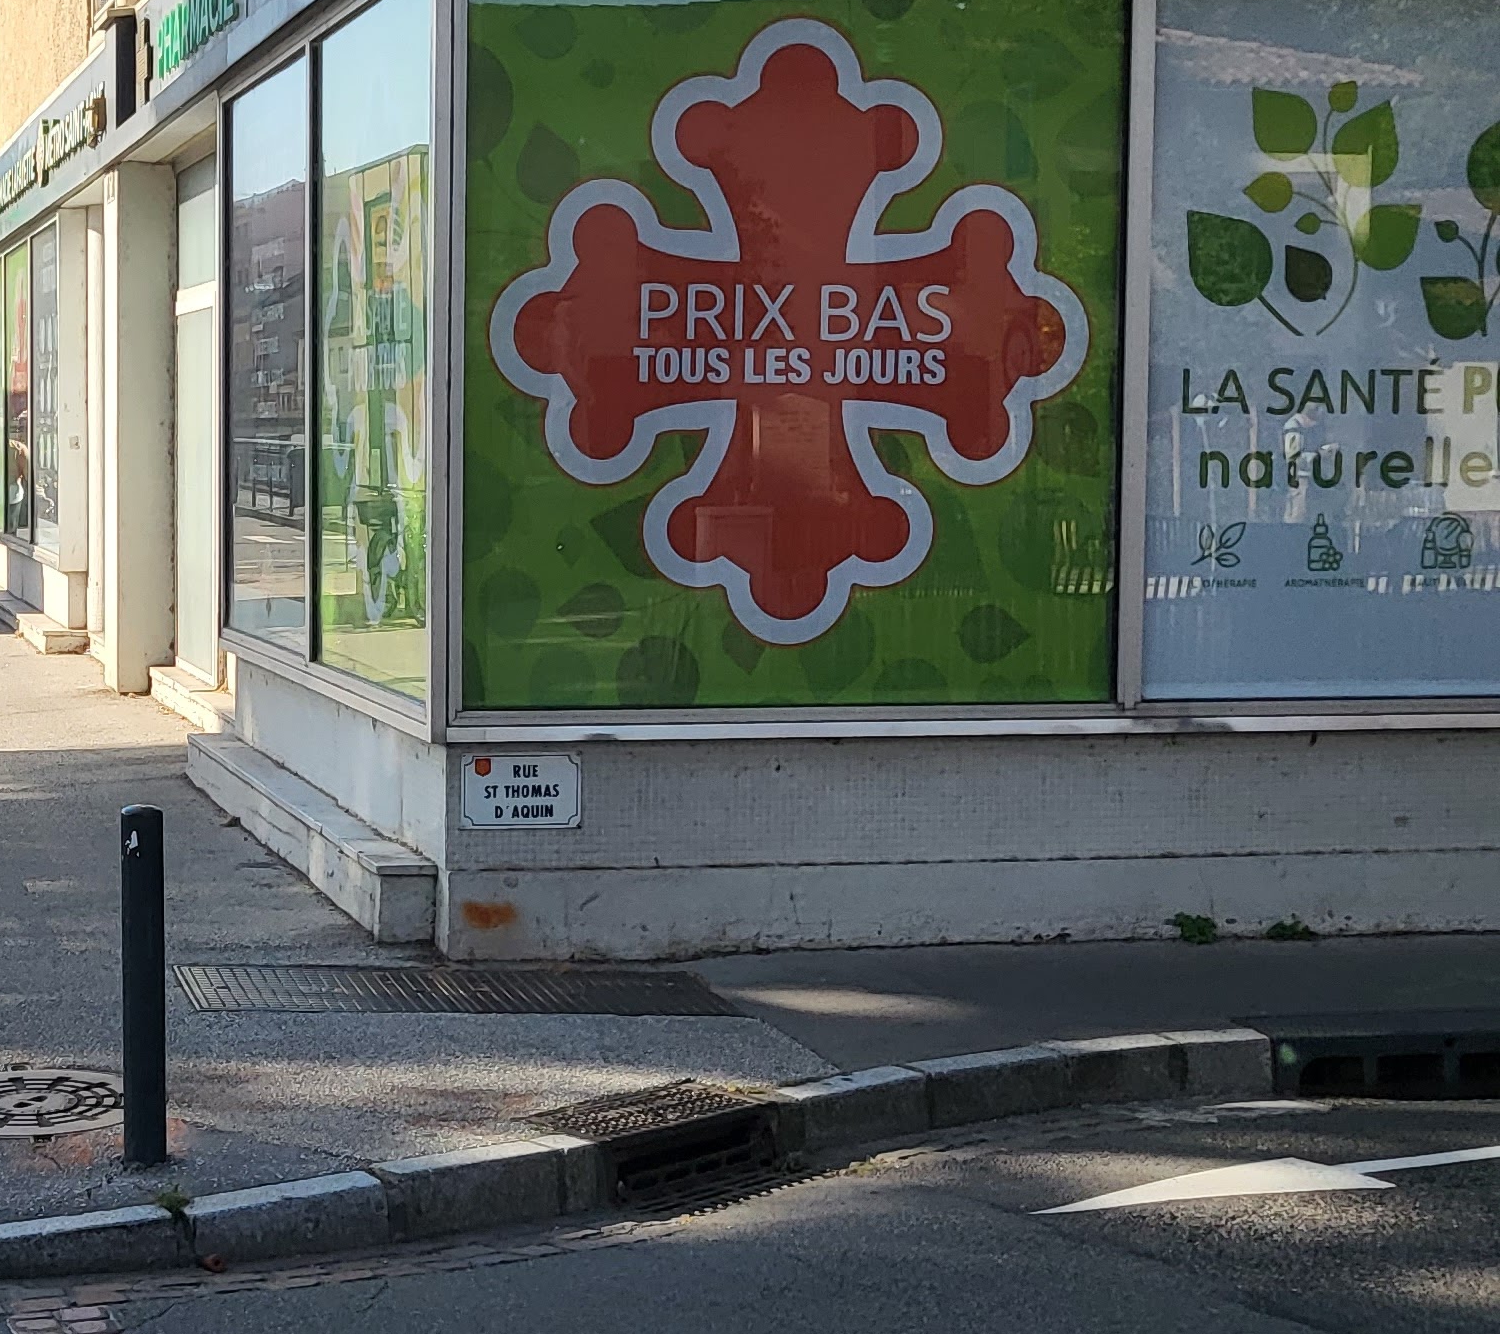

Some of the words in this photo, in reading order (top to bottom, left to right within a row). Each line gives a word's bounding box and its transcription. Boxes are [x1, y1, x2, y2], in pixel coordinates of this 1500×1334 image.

[638, 283, 796, 343] PRIX
[819, 284, 953, 344] BAS
[633, 346, 731, 385] TOUS
[744, 347, 812, 385] LES
[823, 347, 947, 386] JOURS
[1181, 368, 1250, 415] LA
[1265, 357, 1446, 416] SANTÉ
[1461, 365, 1500, 415] P
[1198, 435, 1494, 489] naturelle
[483, 785, 499, 799] ST
[503, 783, 560, 799] THOMAS
[512, 764, 539, 778] RUE
[494, 803, 554, 819] D'AQUIN
